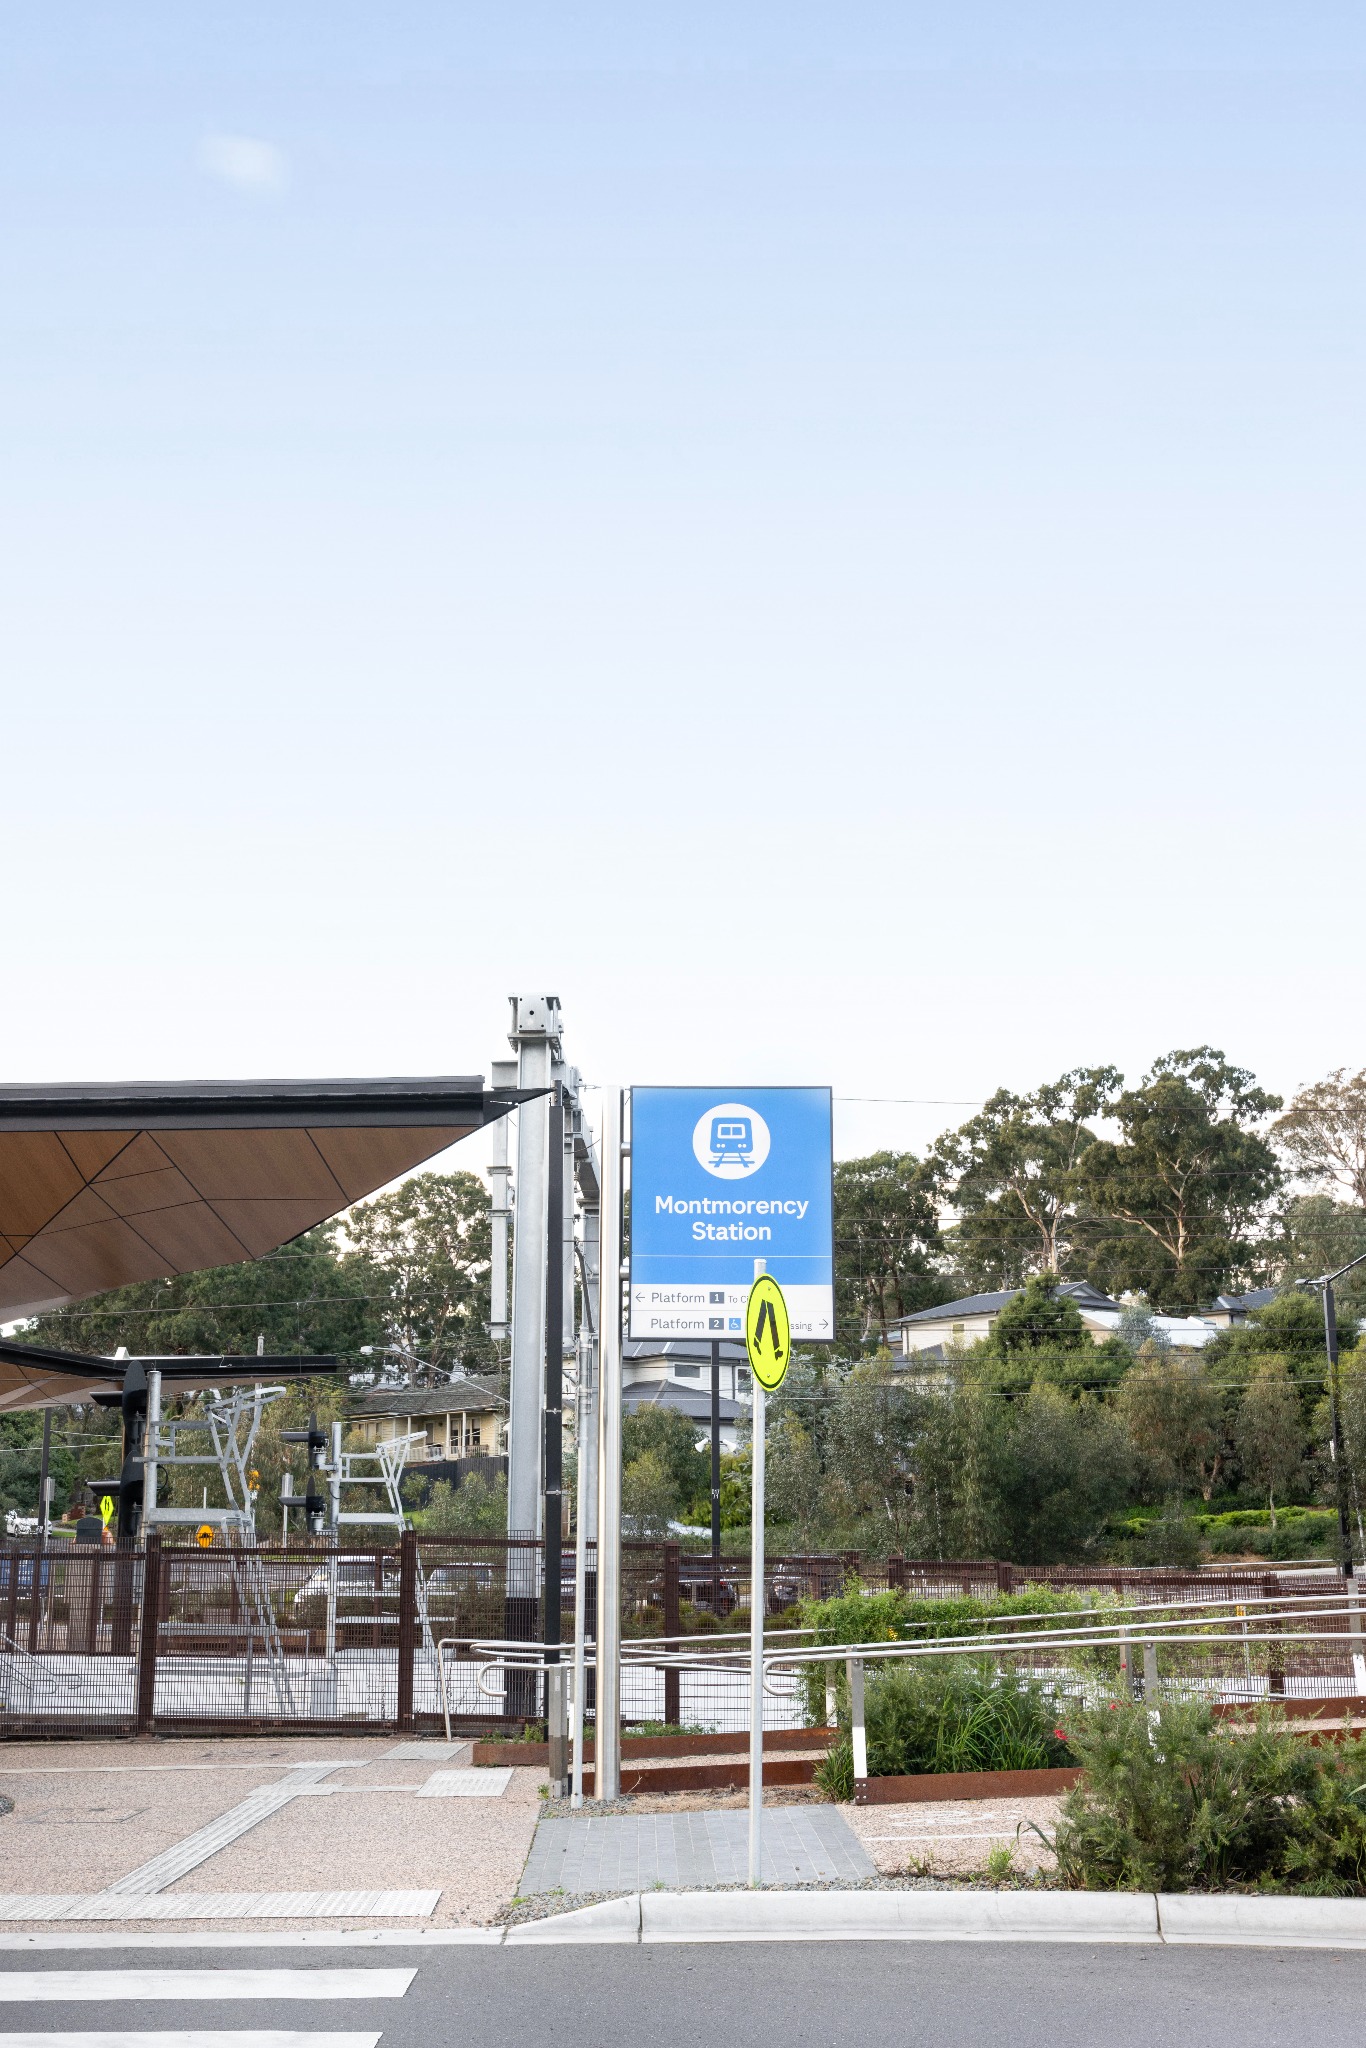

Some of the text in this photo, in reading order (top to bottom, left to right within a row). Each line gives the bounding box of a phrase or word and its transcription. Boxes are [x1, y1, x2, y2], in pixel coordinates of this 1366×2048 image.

[655, 1195, 809, 1220] Montmorency
[692, 1221, 772, 1241] Station
[651, 1292, 705, 1303] Platform
[728, 1295, 738, 1303] To
[740, 1295, 749, 1303] Ci
[650, 1318, 720, 1329] Platform 2
[790, 1321, 812, 1331] ssing
